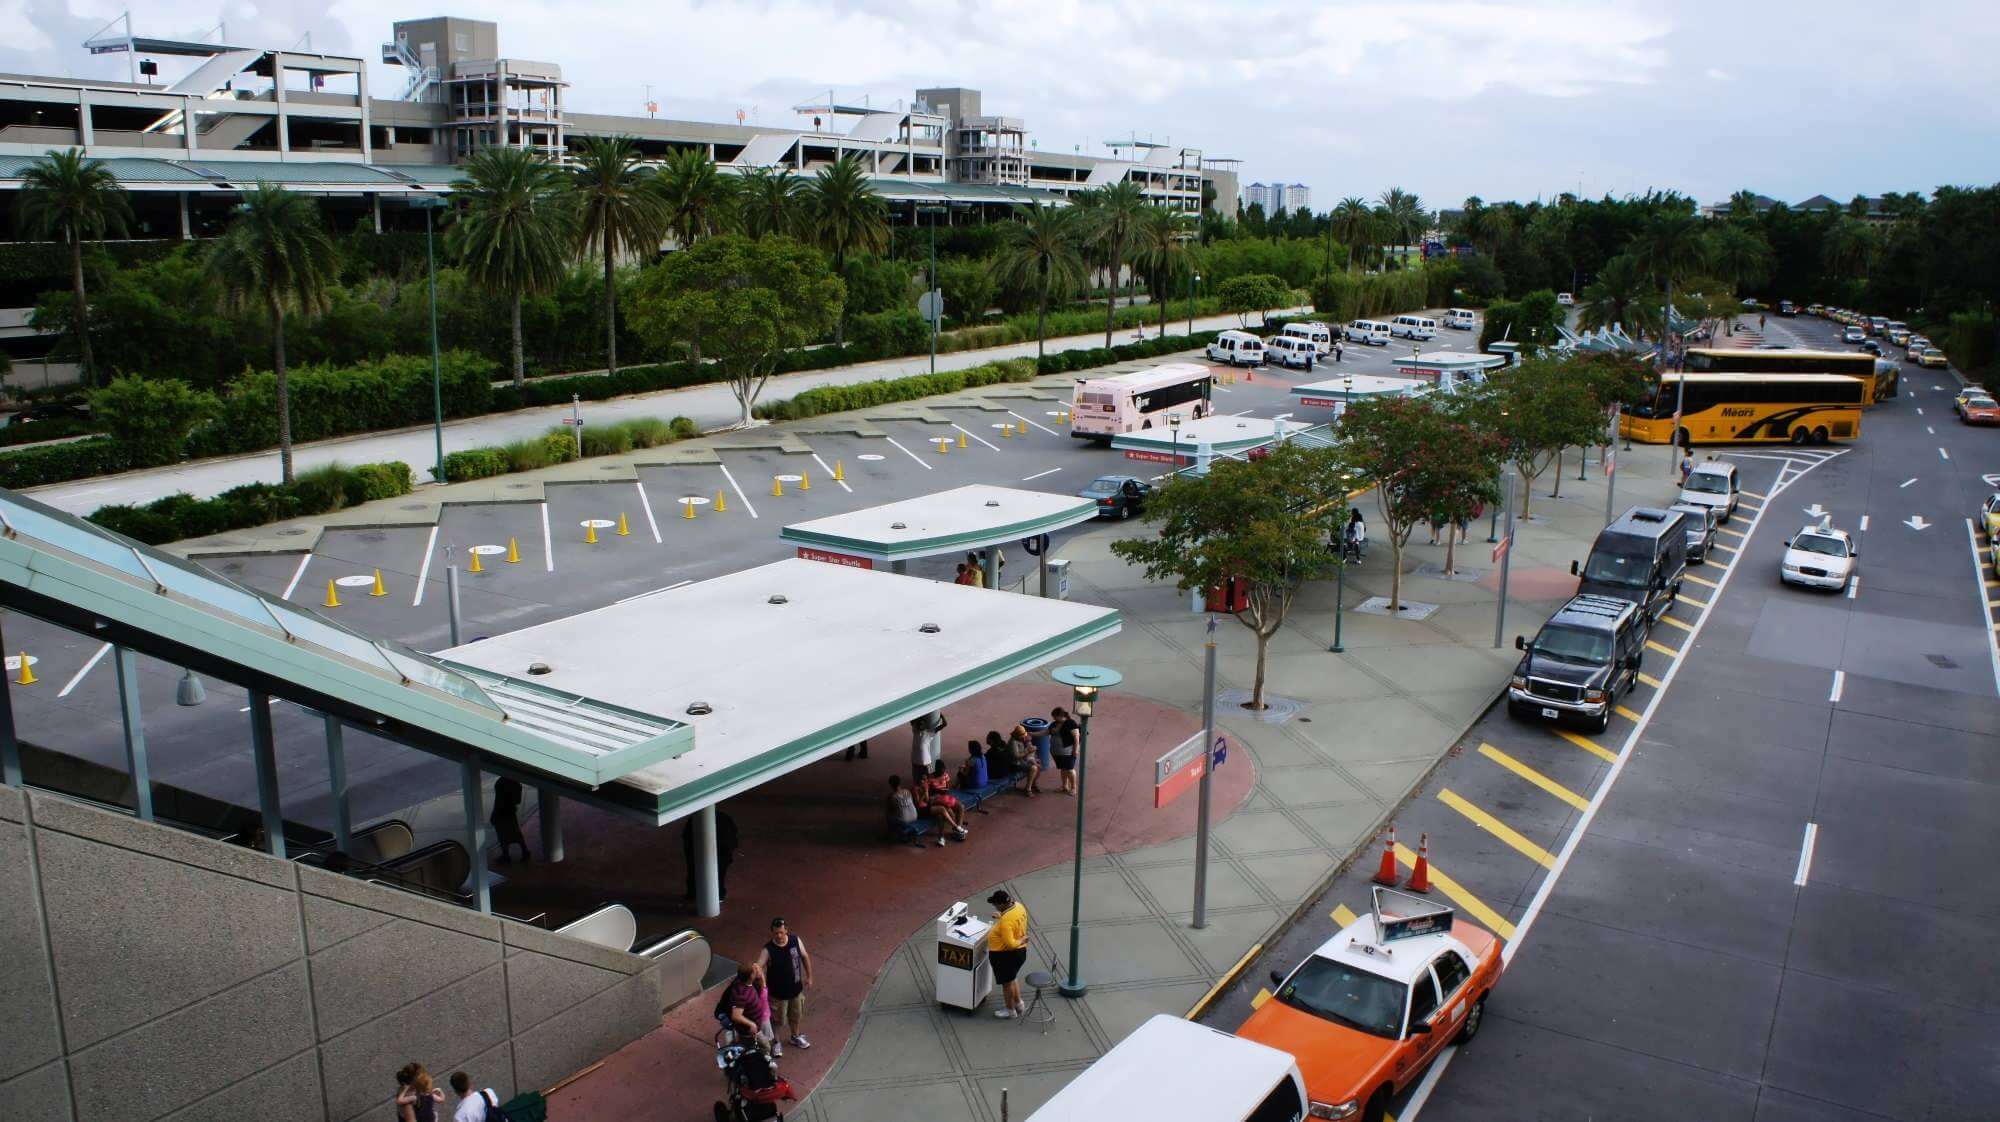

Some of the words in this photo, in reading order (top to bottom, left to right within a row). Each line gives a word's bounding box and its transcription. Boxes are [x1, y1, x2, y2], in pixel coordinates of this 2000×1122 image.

[1721, 407, 1755, 417] Mears
[811, 552, 827, 562] Super
[829, 555, 841, 565] Star
[842, 557, 861, 568] Shuttle
[942, 949, 971, 965] TAXI
